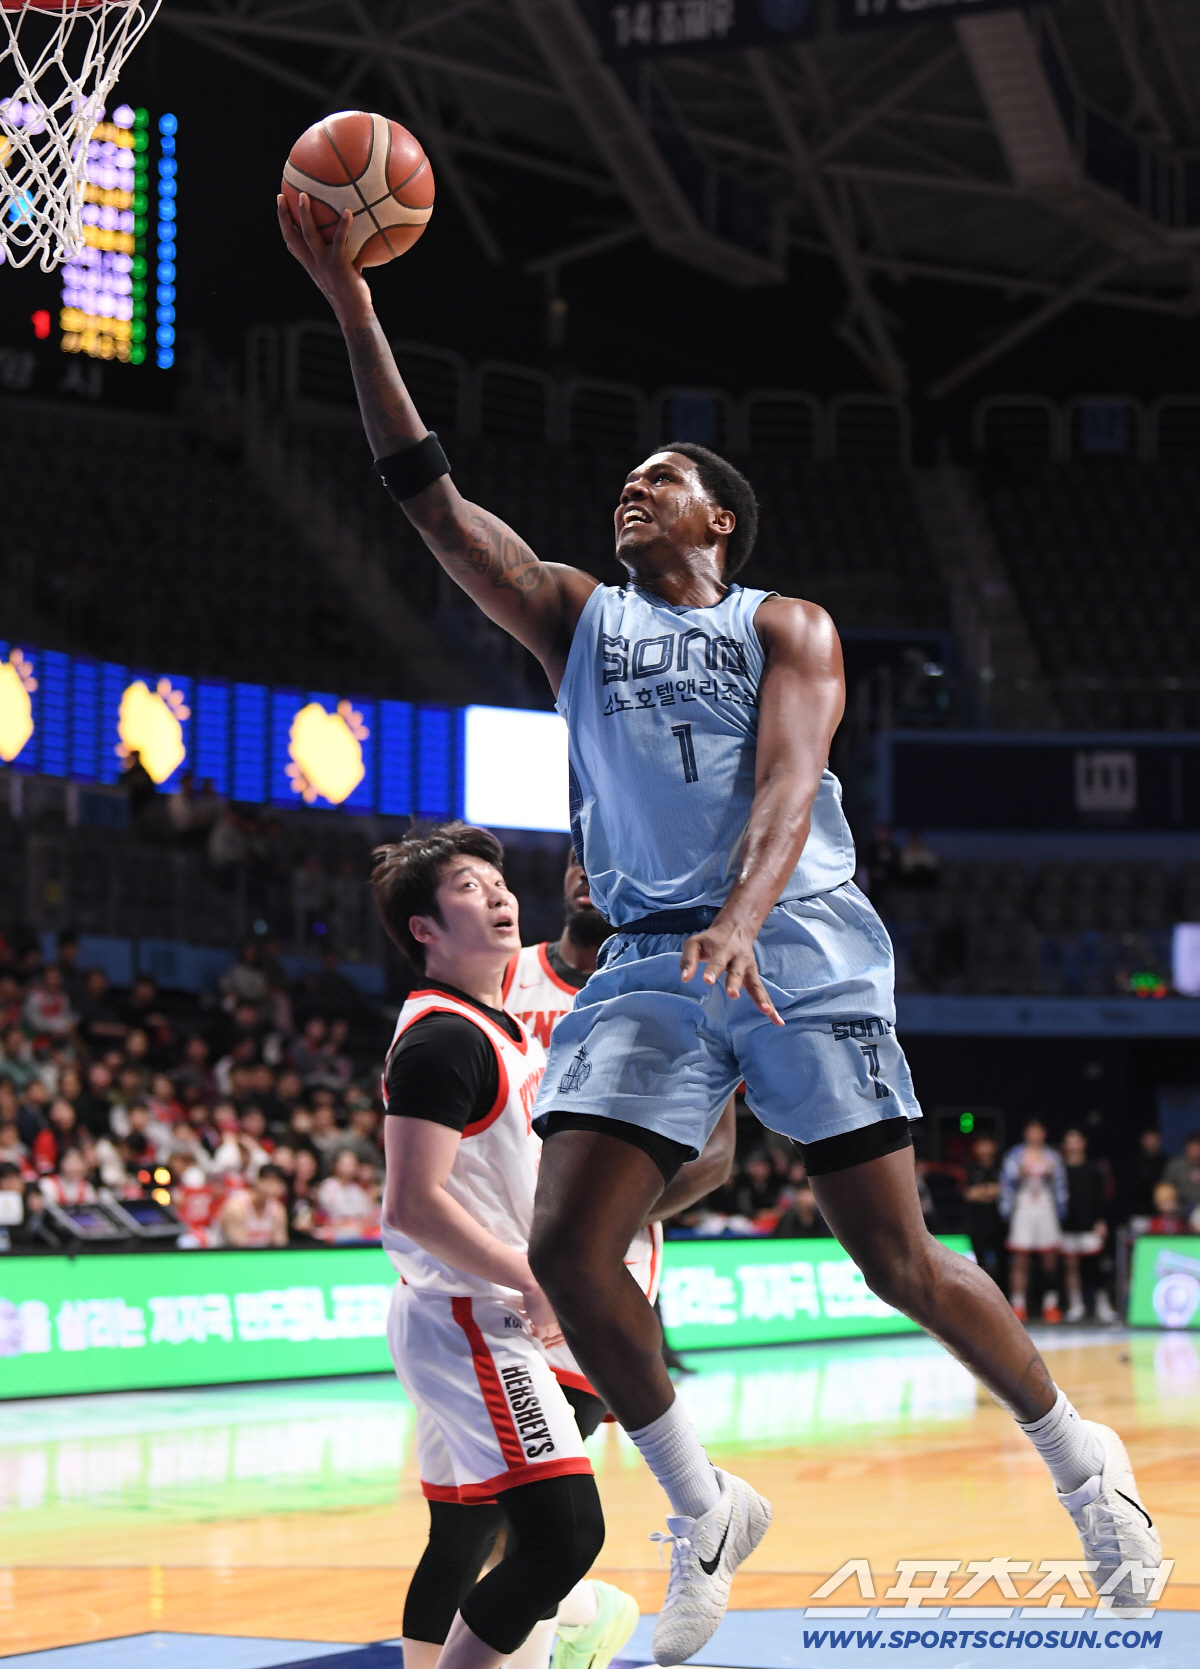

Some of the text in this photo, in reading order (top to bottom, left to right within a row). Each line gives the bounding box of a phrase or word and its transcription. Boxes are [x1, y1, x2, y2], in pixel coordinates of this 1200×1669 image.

[671, 723, 699, 783] 1
[860, 1044, 889, 1099] 1
[501, 1363, 555, 1459] HERSHEY'S
